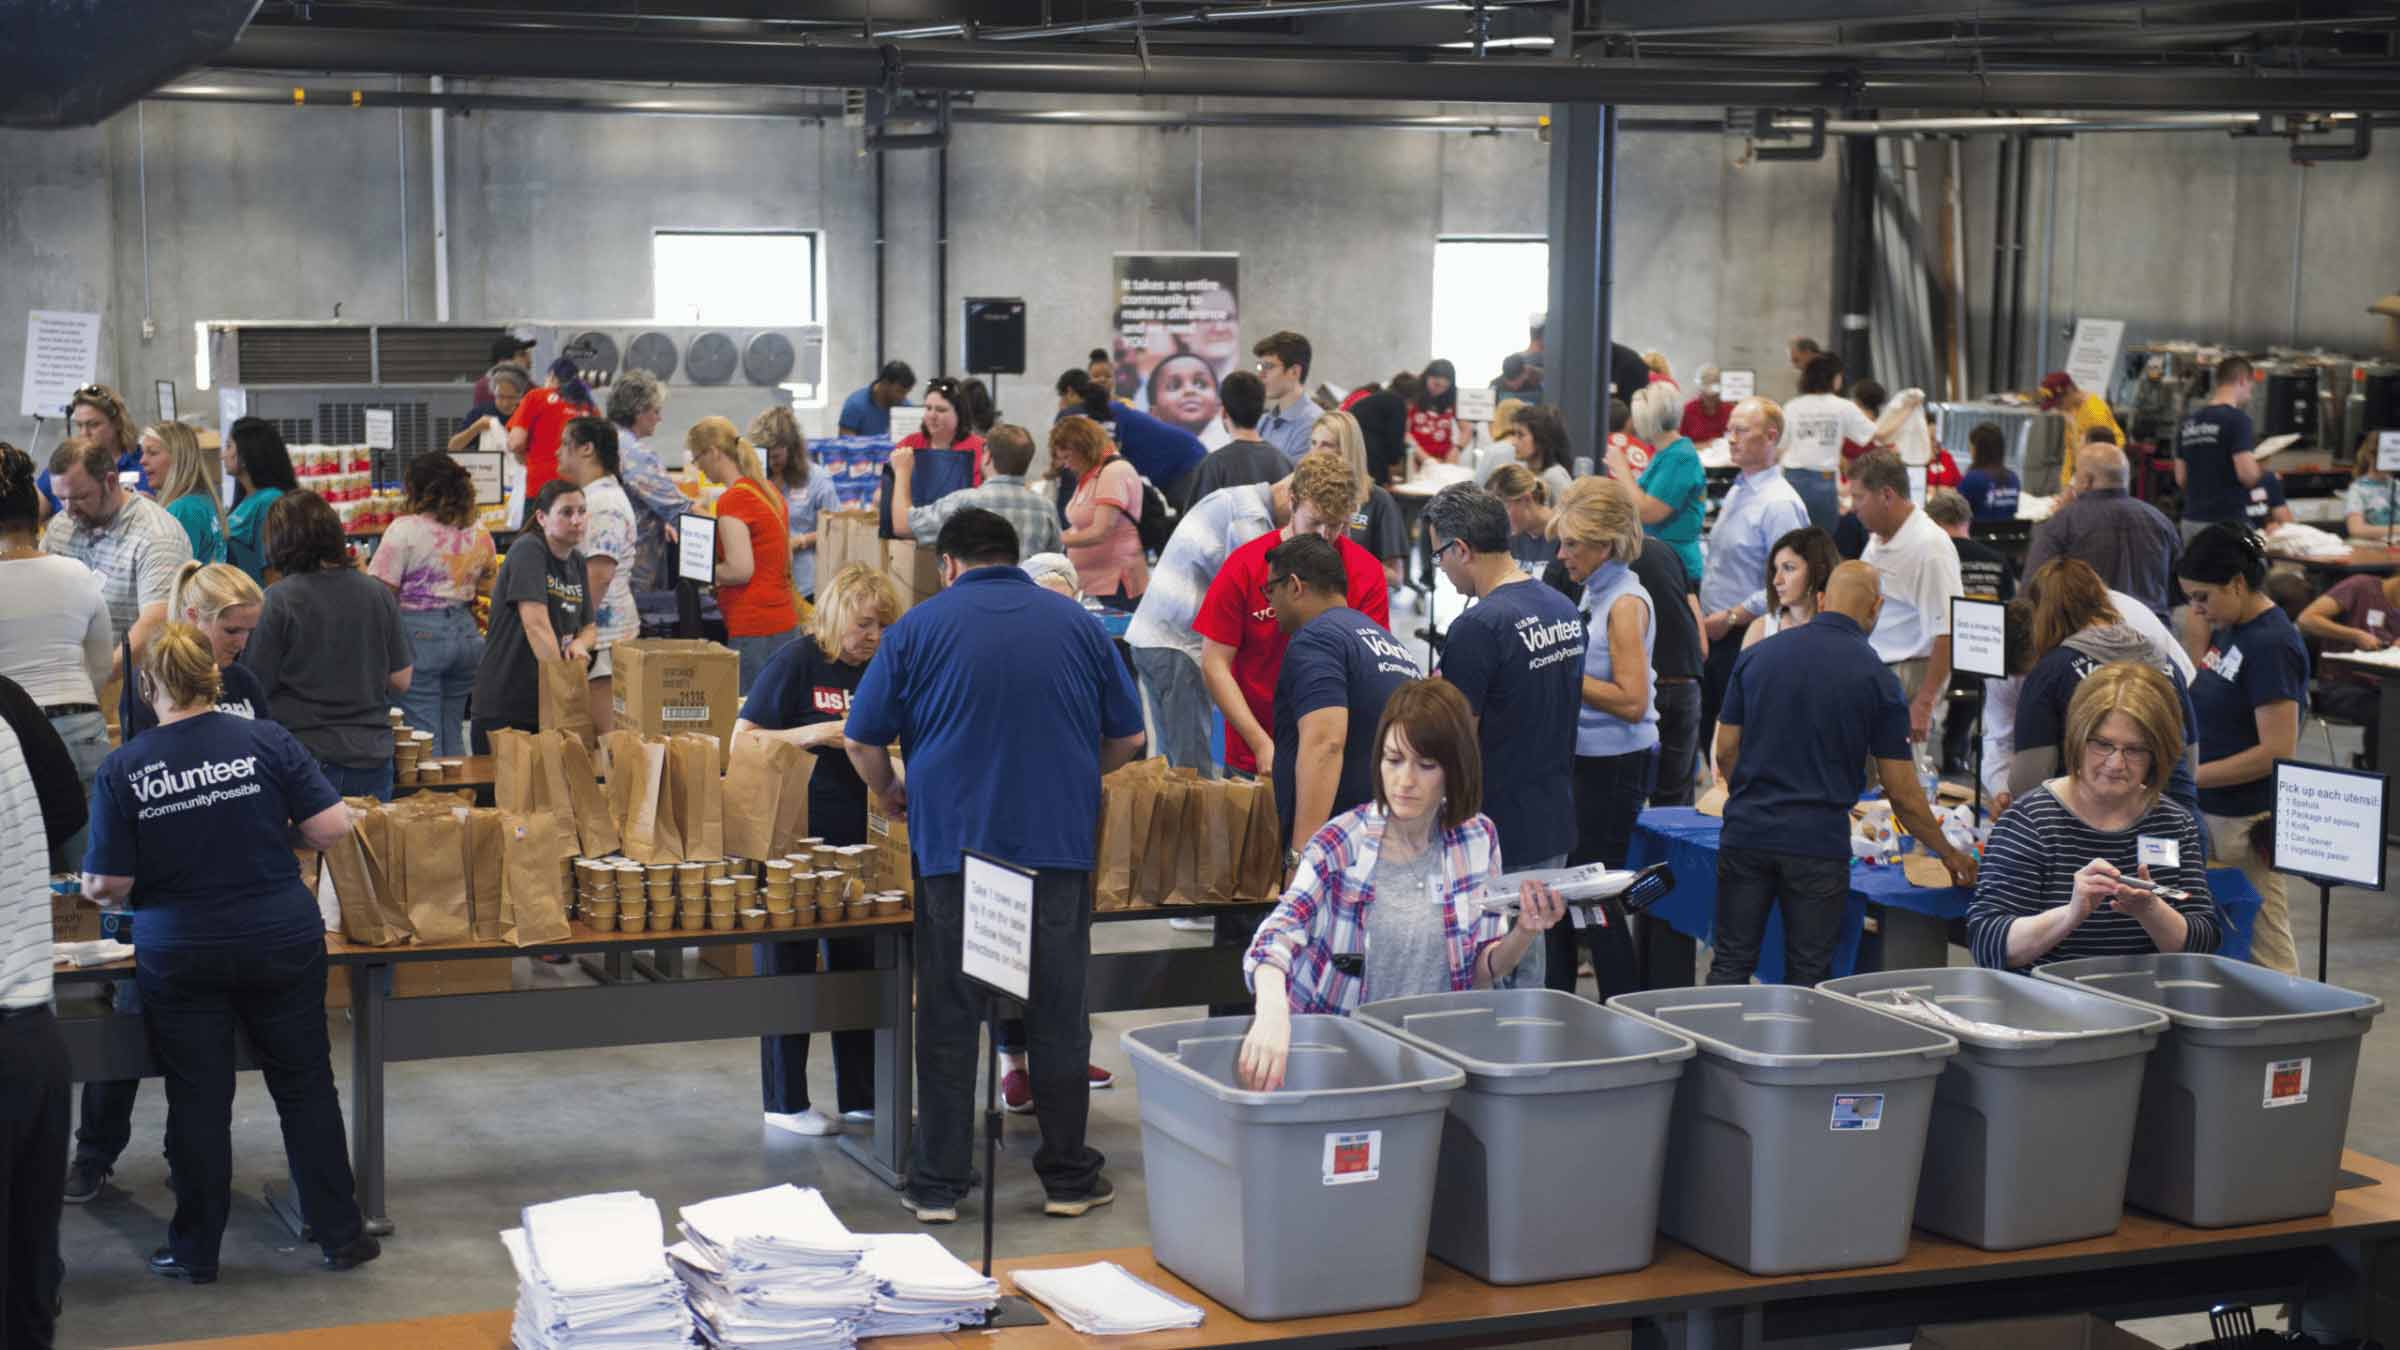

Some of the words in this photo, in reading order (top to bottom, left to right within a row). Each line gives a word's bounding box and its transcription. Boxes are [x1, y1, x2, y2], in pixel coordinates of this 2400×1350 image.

[1121, 280, 1131, 290] It
[1132, 279, 1165, 290] takes
[1167, 281, 1183, 290] an
[1184, 279, 1219, 290] entire
[1121, 294, 1188, 306] community
[1121, 308, 1156, 319] make
[1158, 310, 1166, 319] a
[1167, 308, 1227, 319] difference
[1122, 323, 1145, 333] and
[132, 756, 257, 803] Volunteer
[2279, 780, 2300, 793] Pick
[2302, 786, 2315, 798] up
[2317, 787, 2341, 801] each
[138, 783, 262, 820] #CommunityPossible
[2291, 809, 2322, 823] Package
[2323, 815, 2332, 823] of
[2291, 821, 2310, 832] Knife
[2290, 832, 2306, 842] Can
[2307, 836, 2333, 847] opener
[971, 880, 986, 897] Take
[974, 920, 997, 941] Follow
